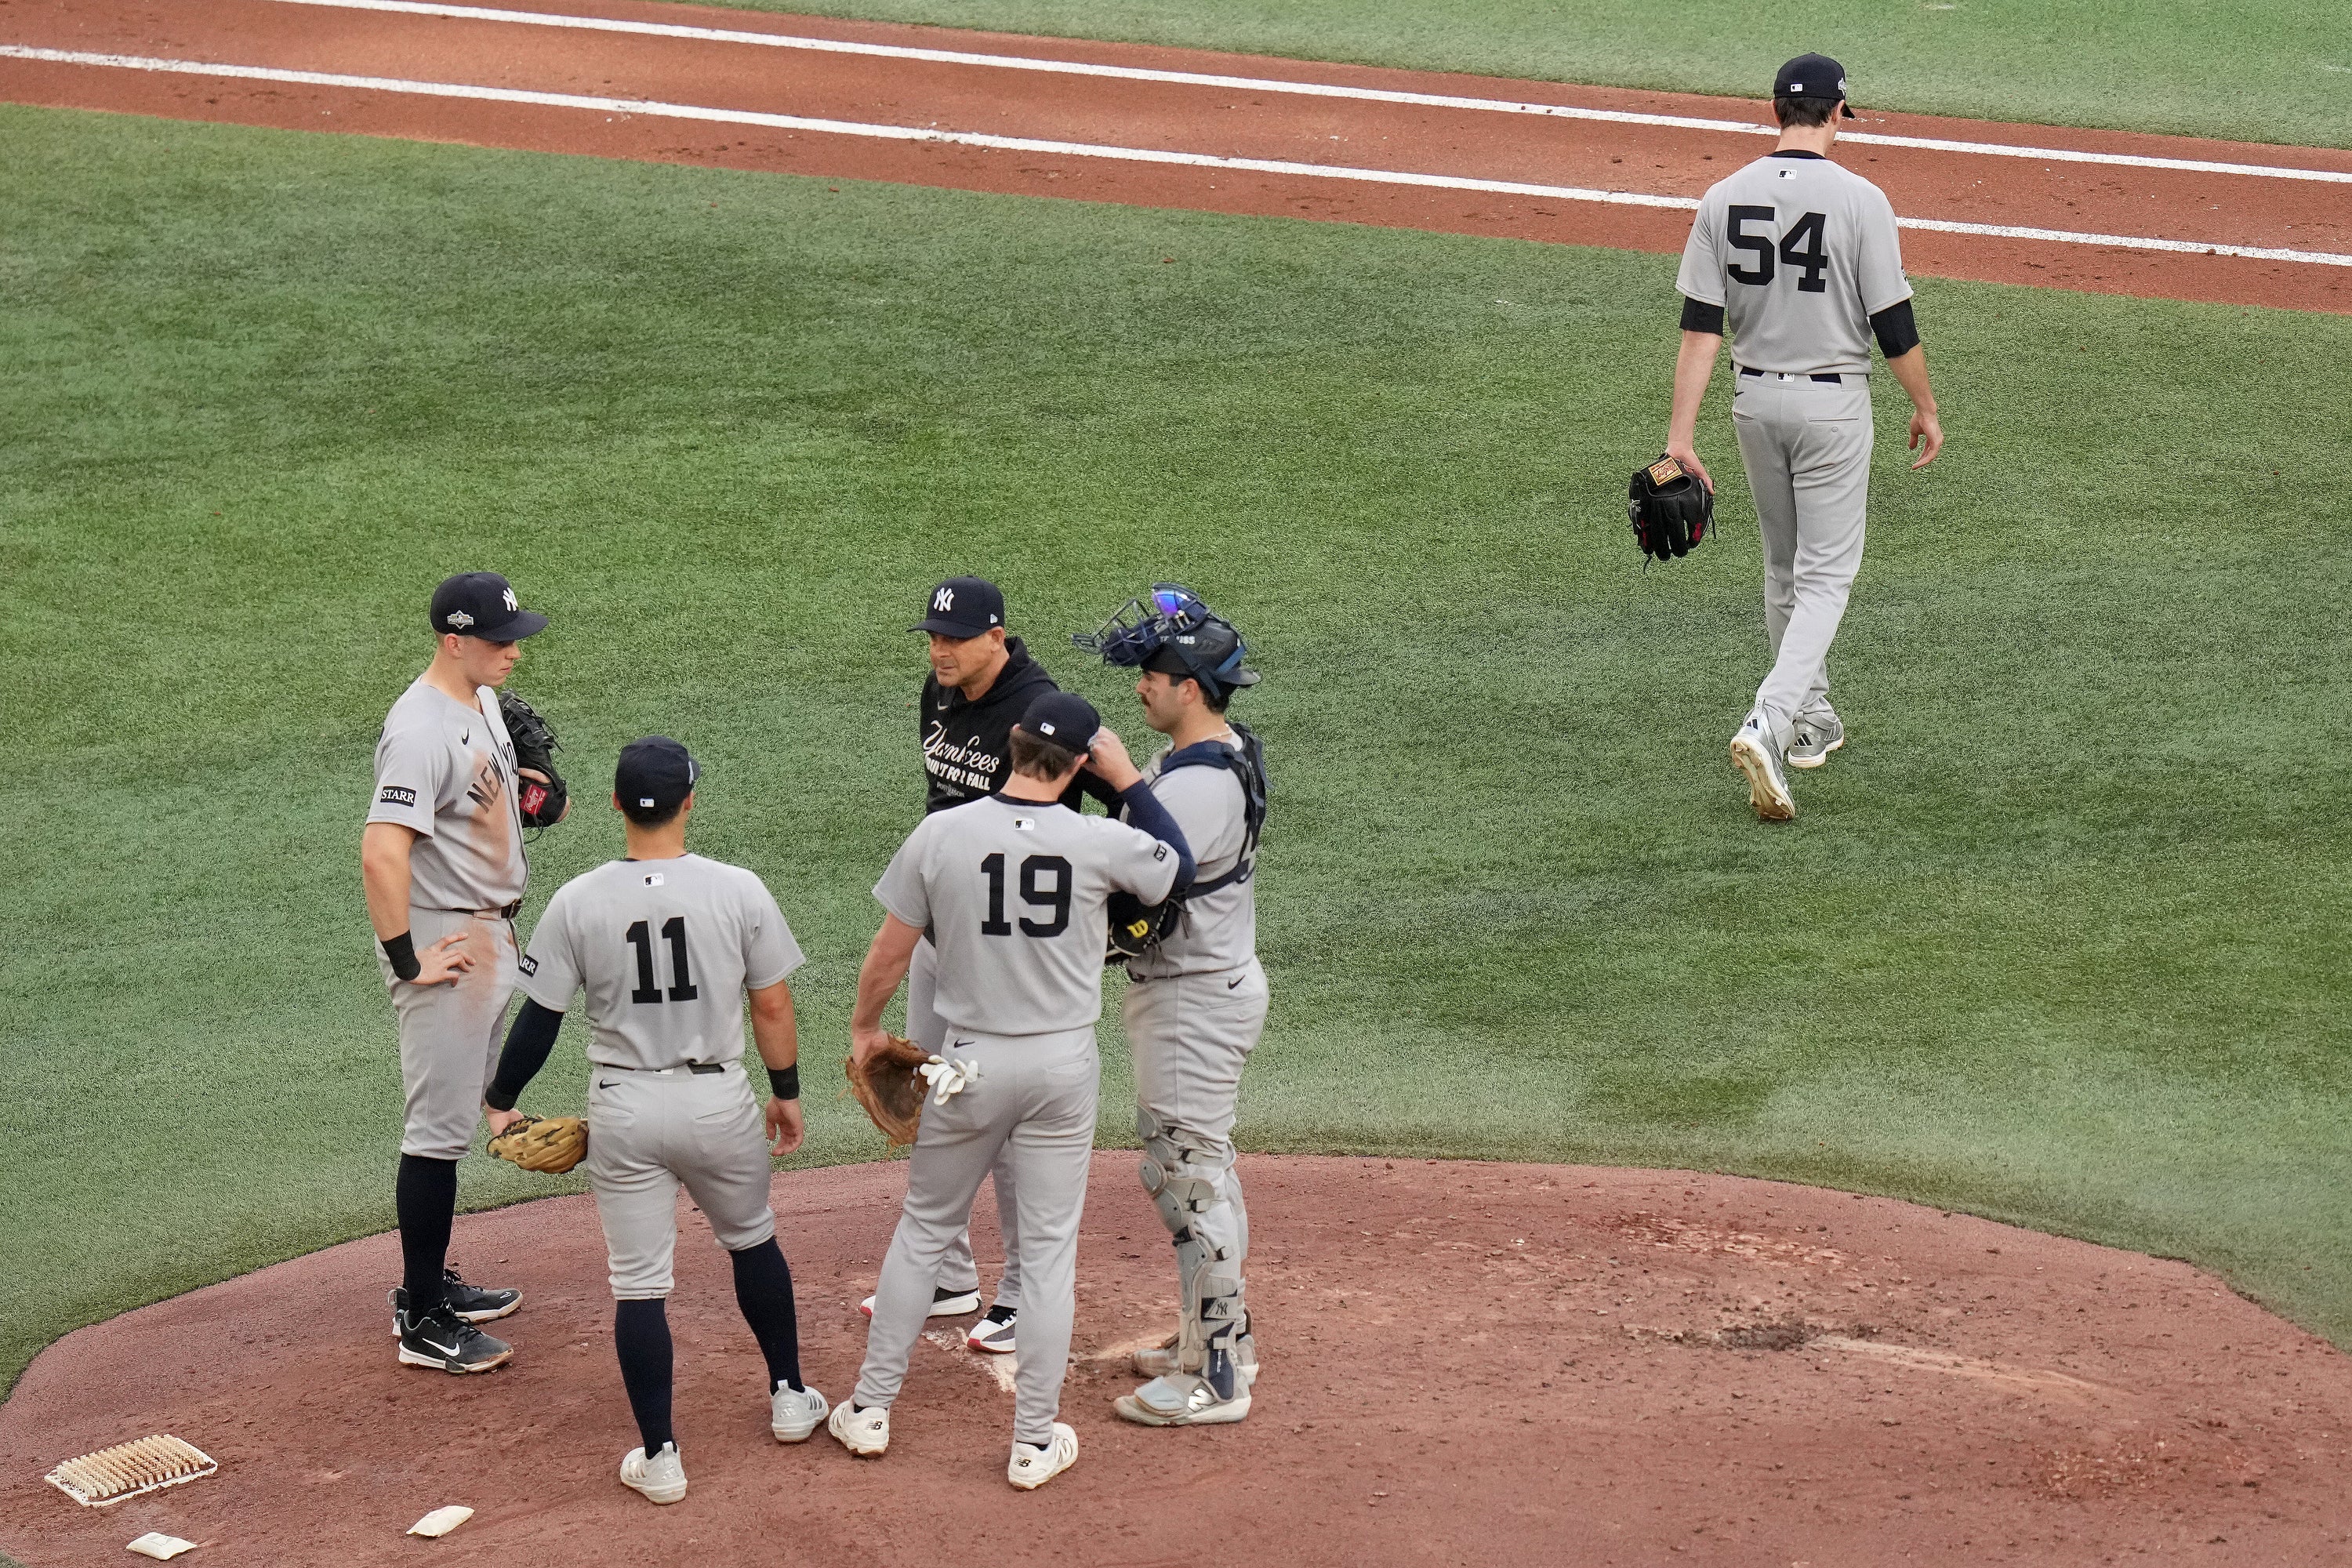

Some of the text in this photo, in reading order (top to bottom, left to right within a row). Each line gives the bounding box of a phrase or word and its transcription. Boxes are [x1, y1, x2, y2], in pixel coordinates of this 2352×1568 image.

[1727, 205, 1828, 292] 54
[503, 586, 518, 612] NY
[933, 587, 954, 612] NY
[923, 720, 1000, 773] Yankees
[381, 789, 415, 804] STARR
[466, 742, 518, 814] NEW YO
[966, 771, 990, 791] FALL
[981, 853, 1073, 938] 19
[626, 916, 697, 1004] 11
[1215, 1301, 1229, 1316] NY
